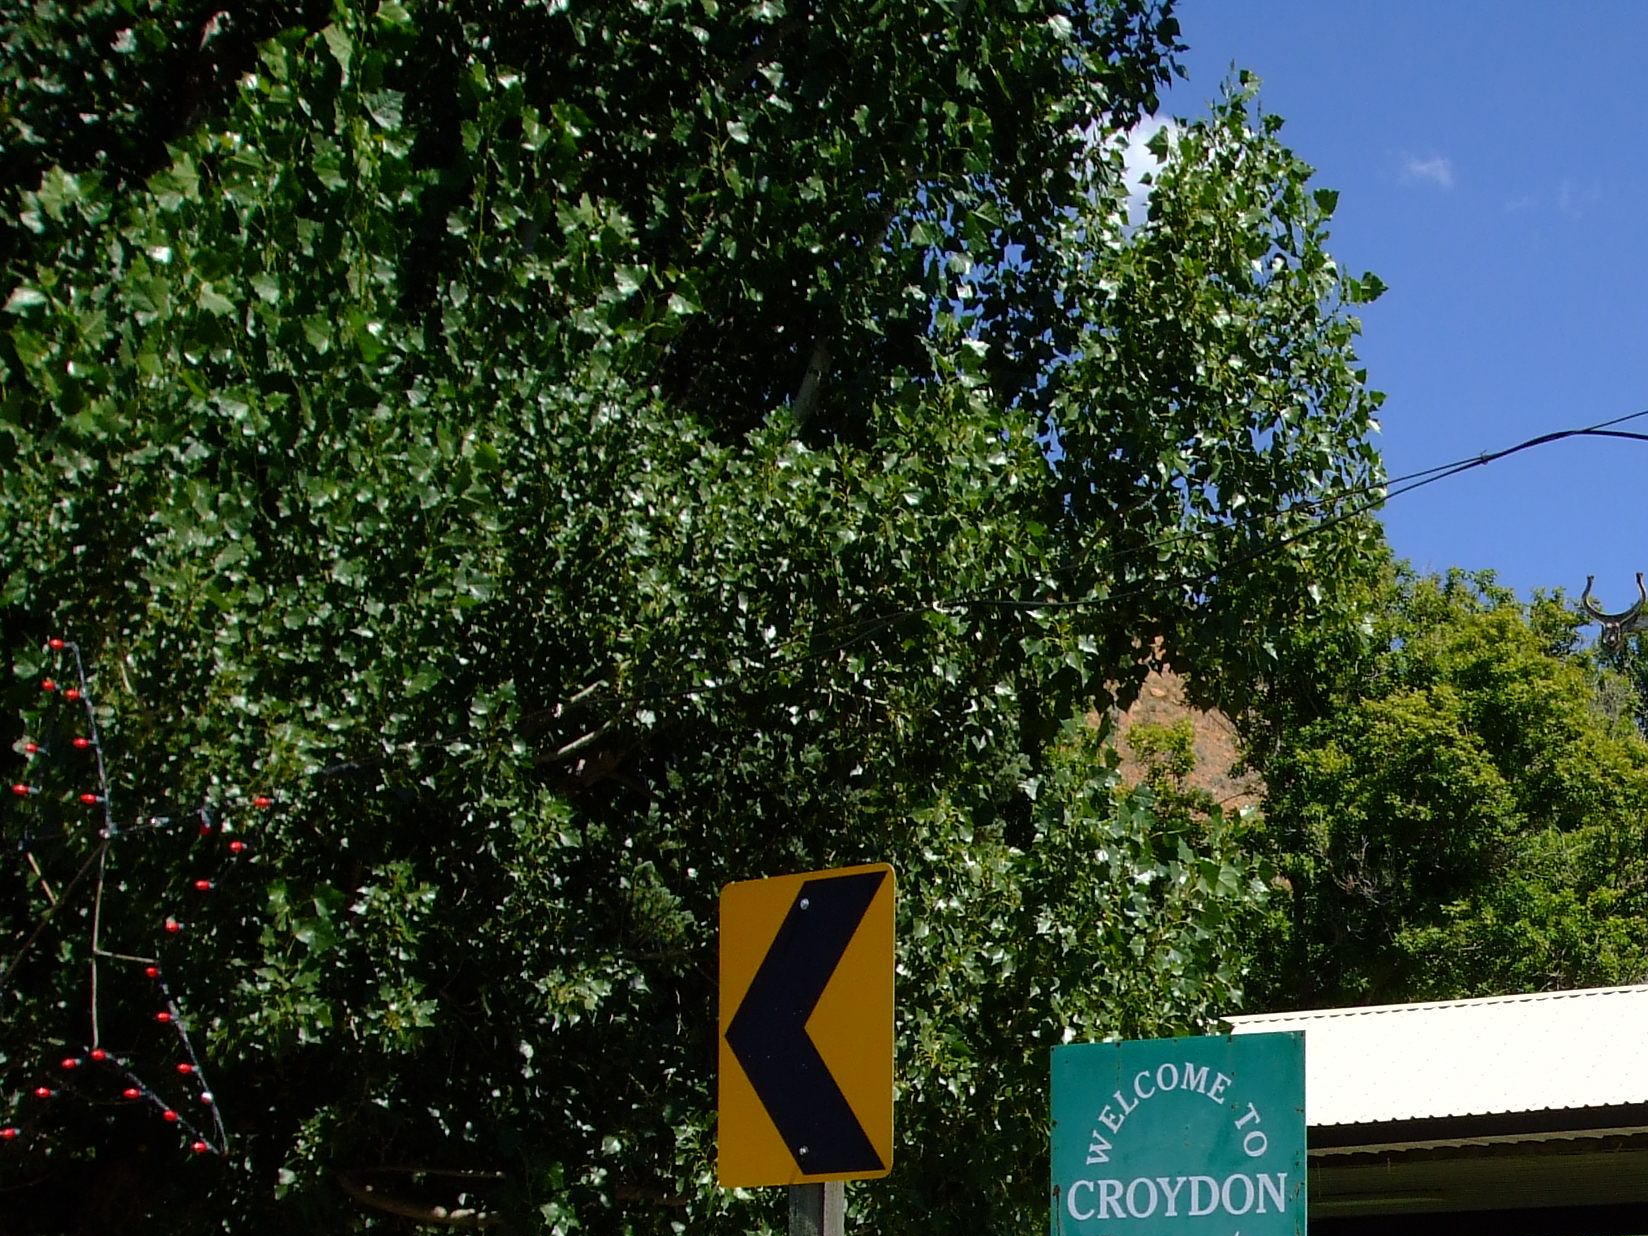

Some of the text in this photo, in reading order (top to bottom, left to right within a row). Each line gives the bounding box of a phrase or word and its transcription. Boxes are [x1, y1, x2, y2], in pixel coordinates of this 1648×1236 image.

[1086, 1062, 1267, 1165] WELCOME TO
[1067, 1172, 1287, 1220] CROYDON
